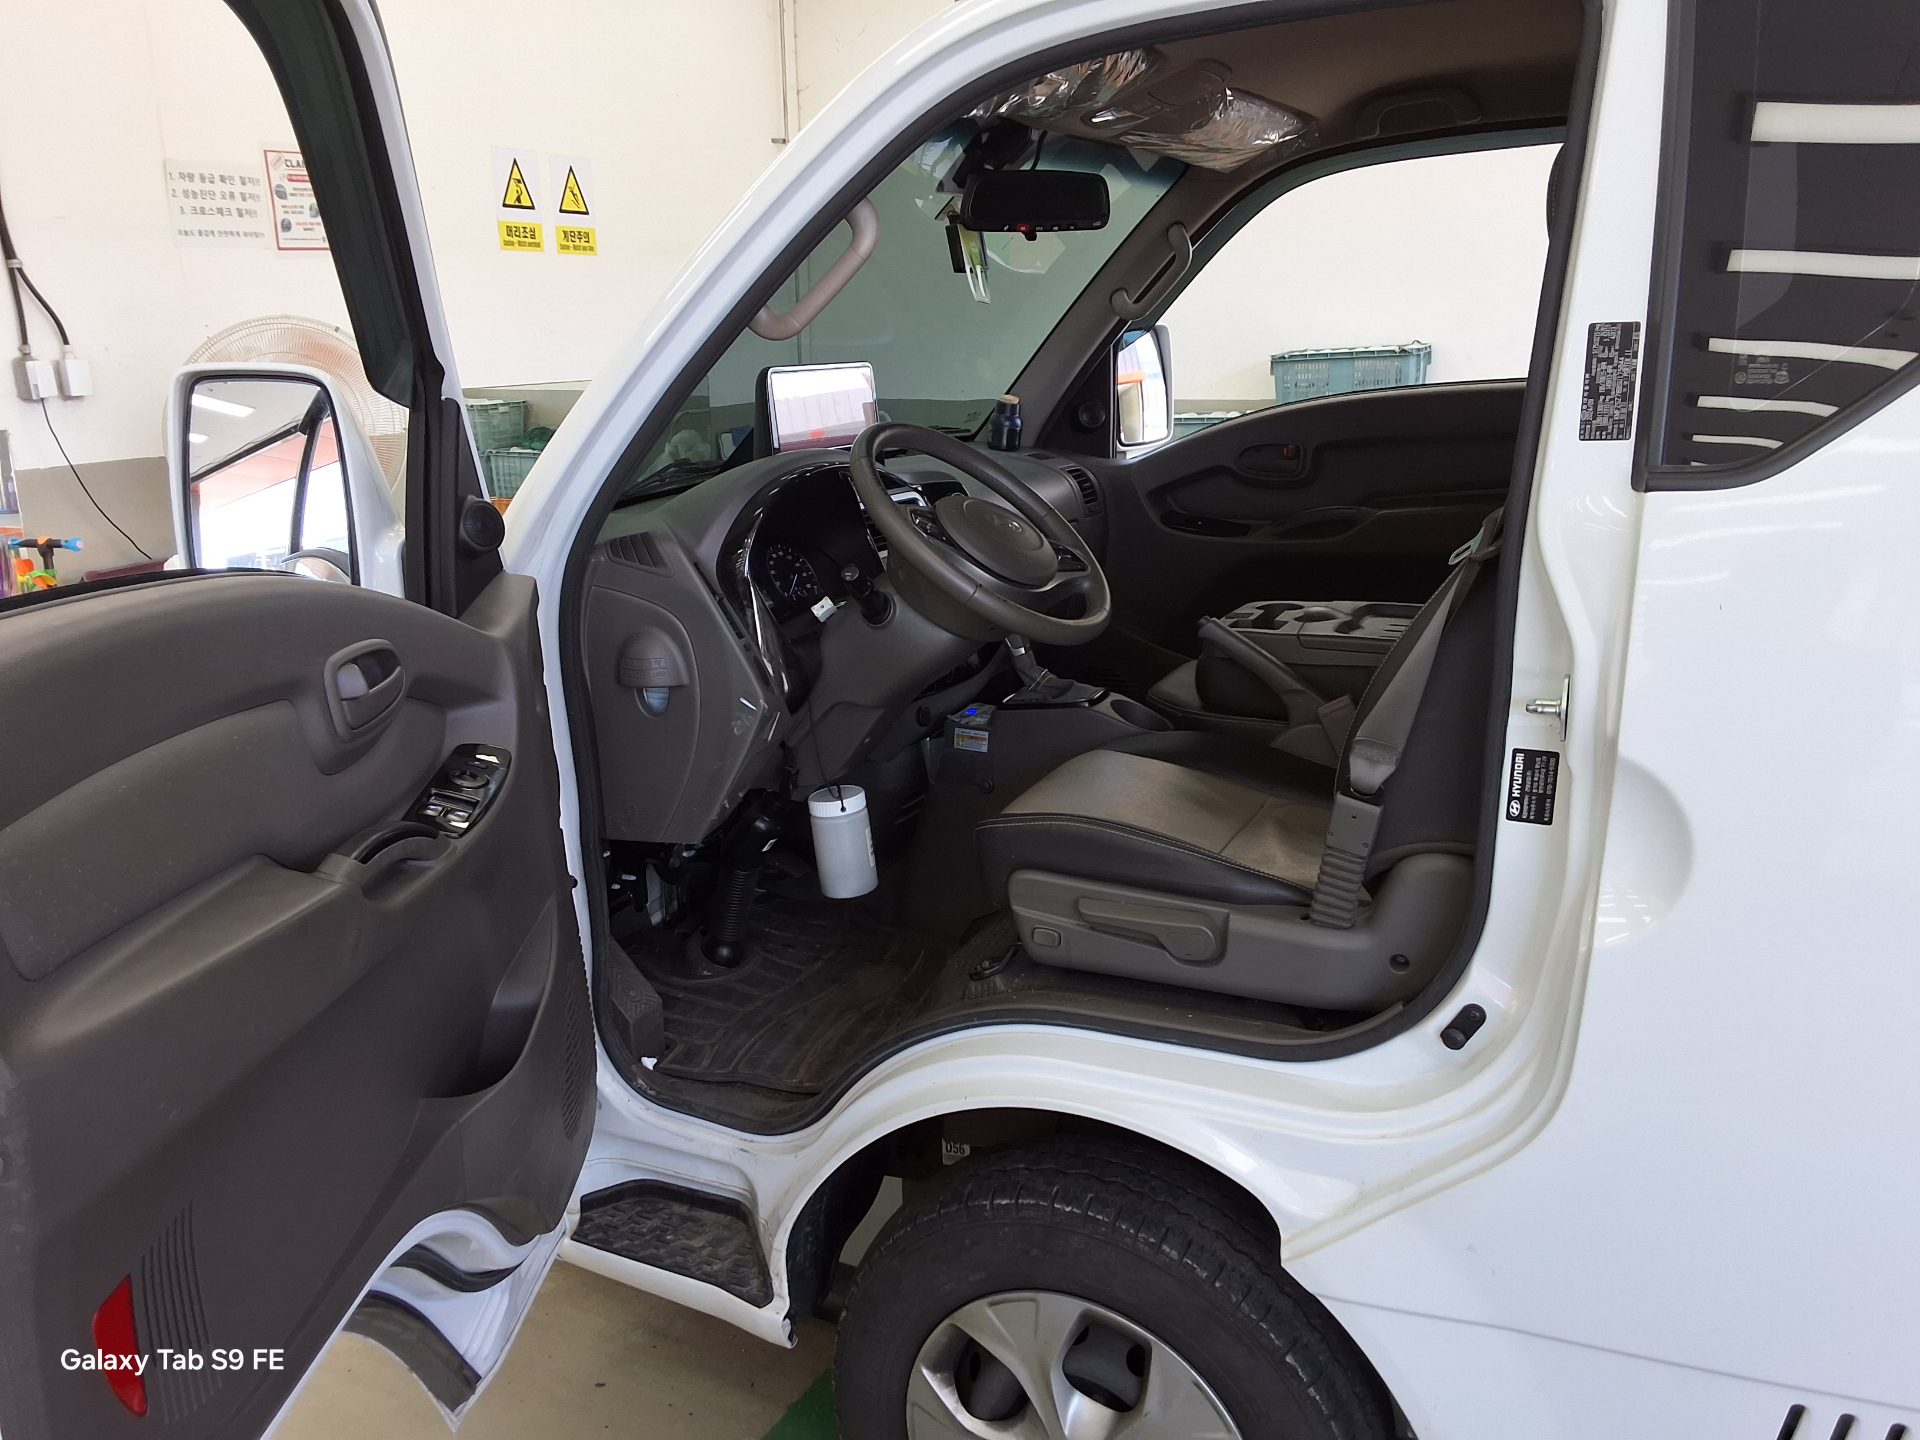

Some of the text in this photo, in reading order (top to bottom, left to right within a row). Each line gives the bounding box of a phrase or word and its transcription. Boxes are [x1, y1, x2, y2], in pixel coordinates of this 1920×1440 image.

[505, 224, 537, 240] 머리조심
[562, 229, 590, 243] 계단주의
[1512, 753, 1525, 797] HYUNDAI
